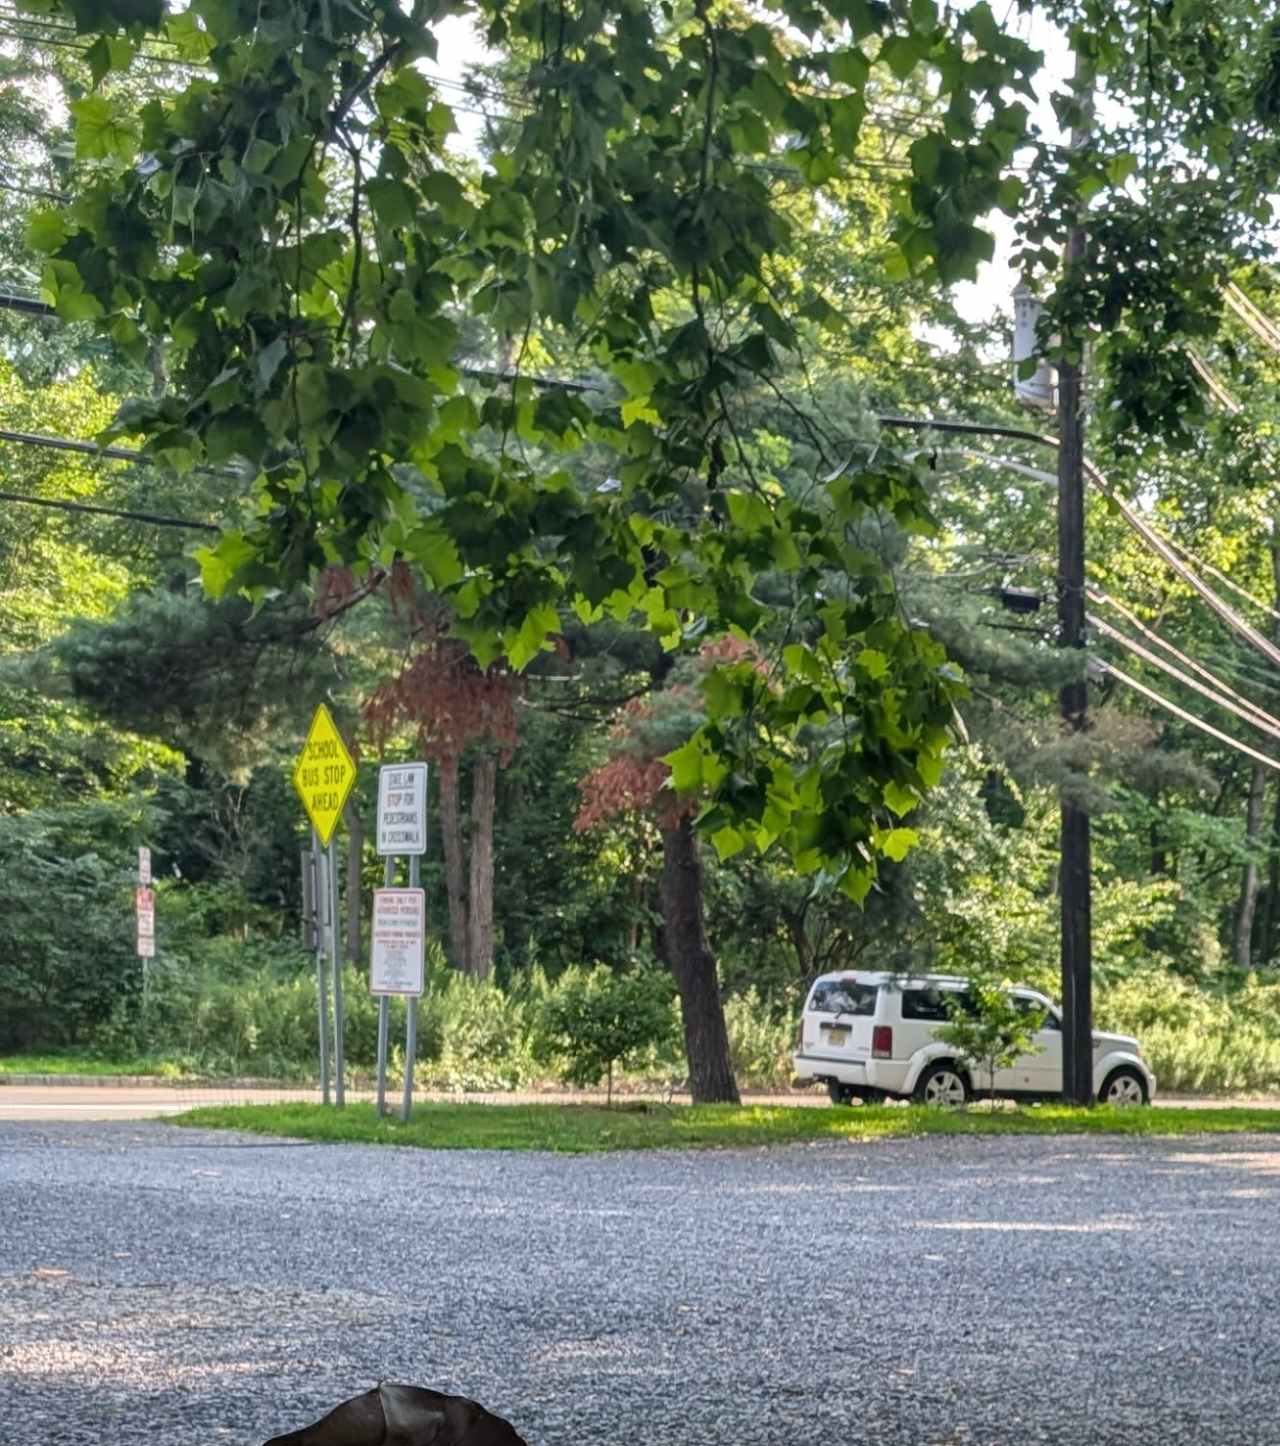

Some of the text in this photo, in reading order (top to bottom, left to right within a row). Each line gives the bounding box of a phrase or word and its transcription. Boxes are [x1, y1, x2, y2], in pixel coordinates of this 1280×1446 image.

[307, 739, 339, 760] SCHOOL
[302, 764, 346, 787] BUS STOP
[311, 791, 339, 811] AHEAD
[387, 792, 415, 808] STOP FOR
